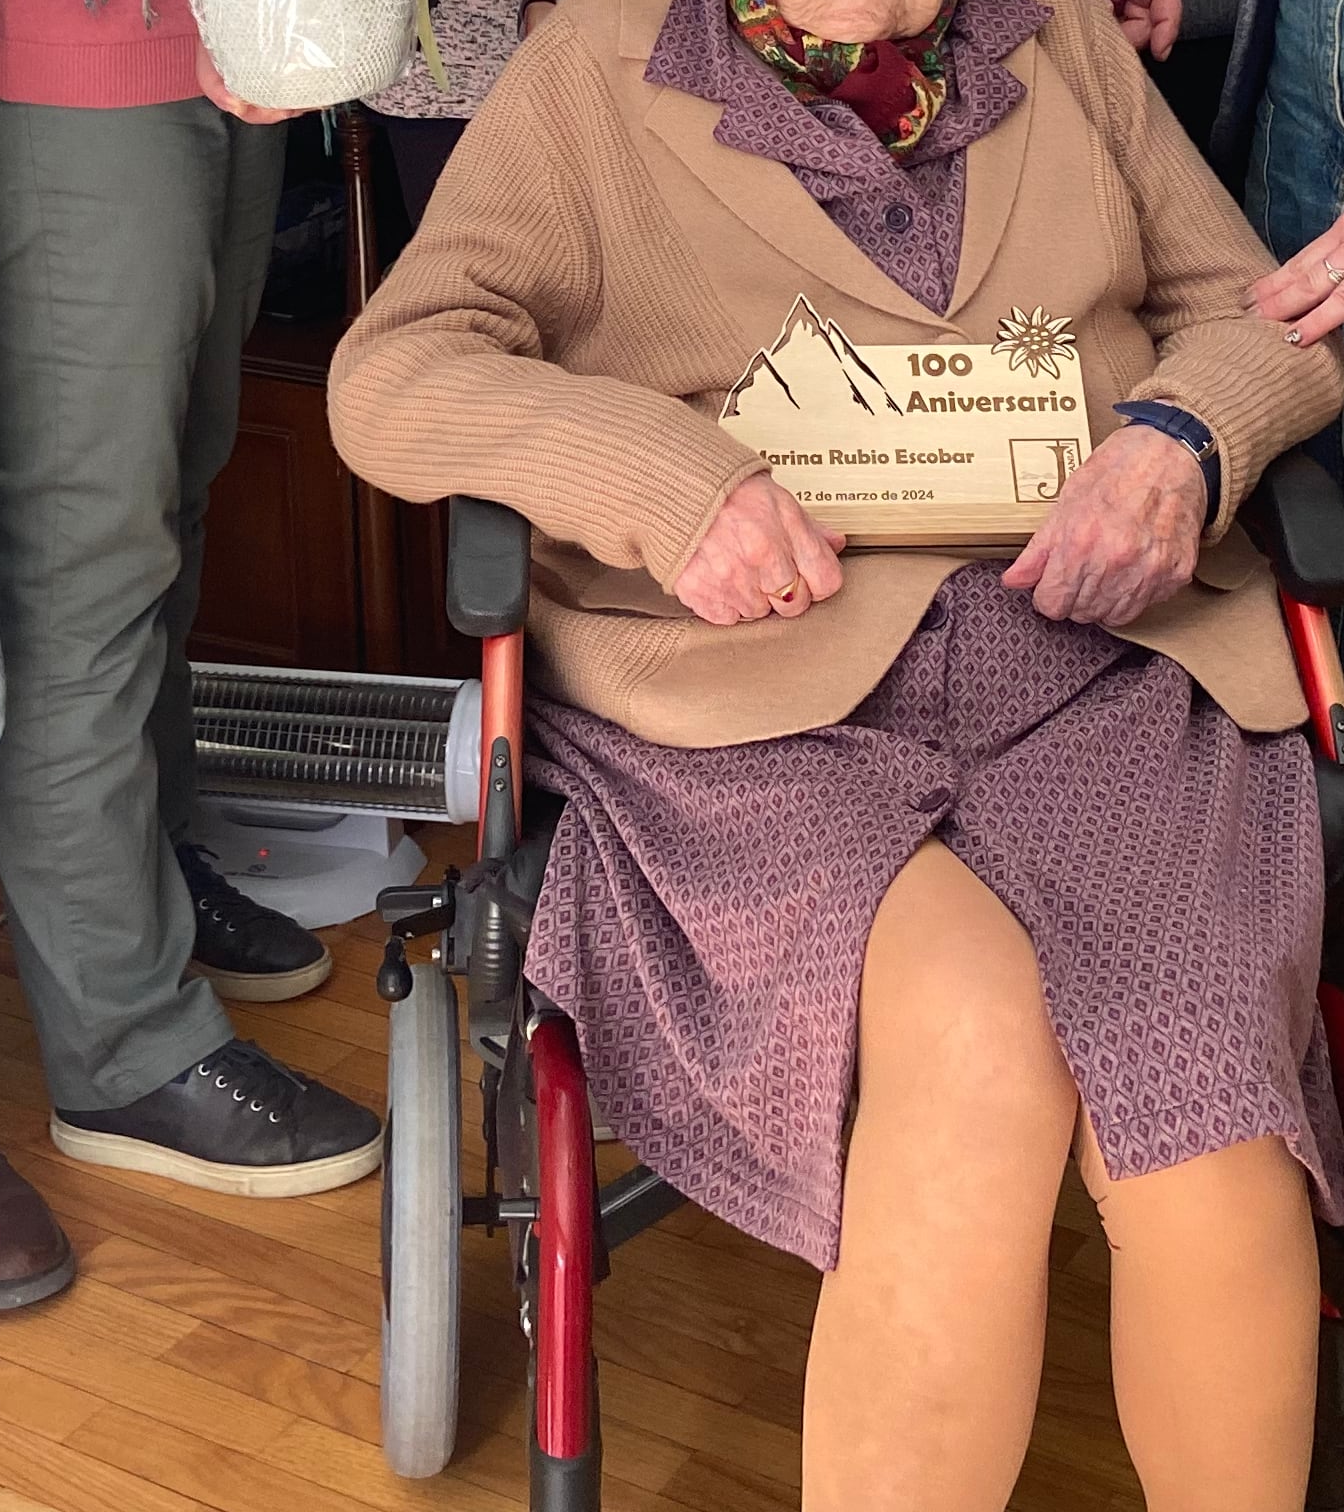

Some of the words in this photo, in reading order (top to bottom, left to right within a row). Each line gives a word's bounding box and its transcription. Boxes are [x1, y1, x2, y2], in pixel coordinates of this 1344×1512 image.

[907, 353, 973, 377] 100
[906, 390, 1077, 413] Aniversario
[829, 449, 890, 465] Rubio
[895, 448, 975, 465] Escobar
[796, 491, 812, 502] 12
[815, 491, 832, 502] de
[835, 492, 878, 502] marzo
[881, 490, 898, 501] de
[901, 490, 935, 501] 2024
